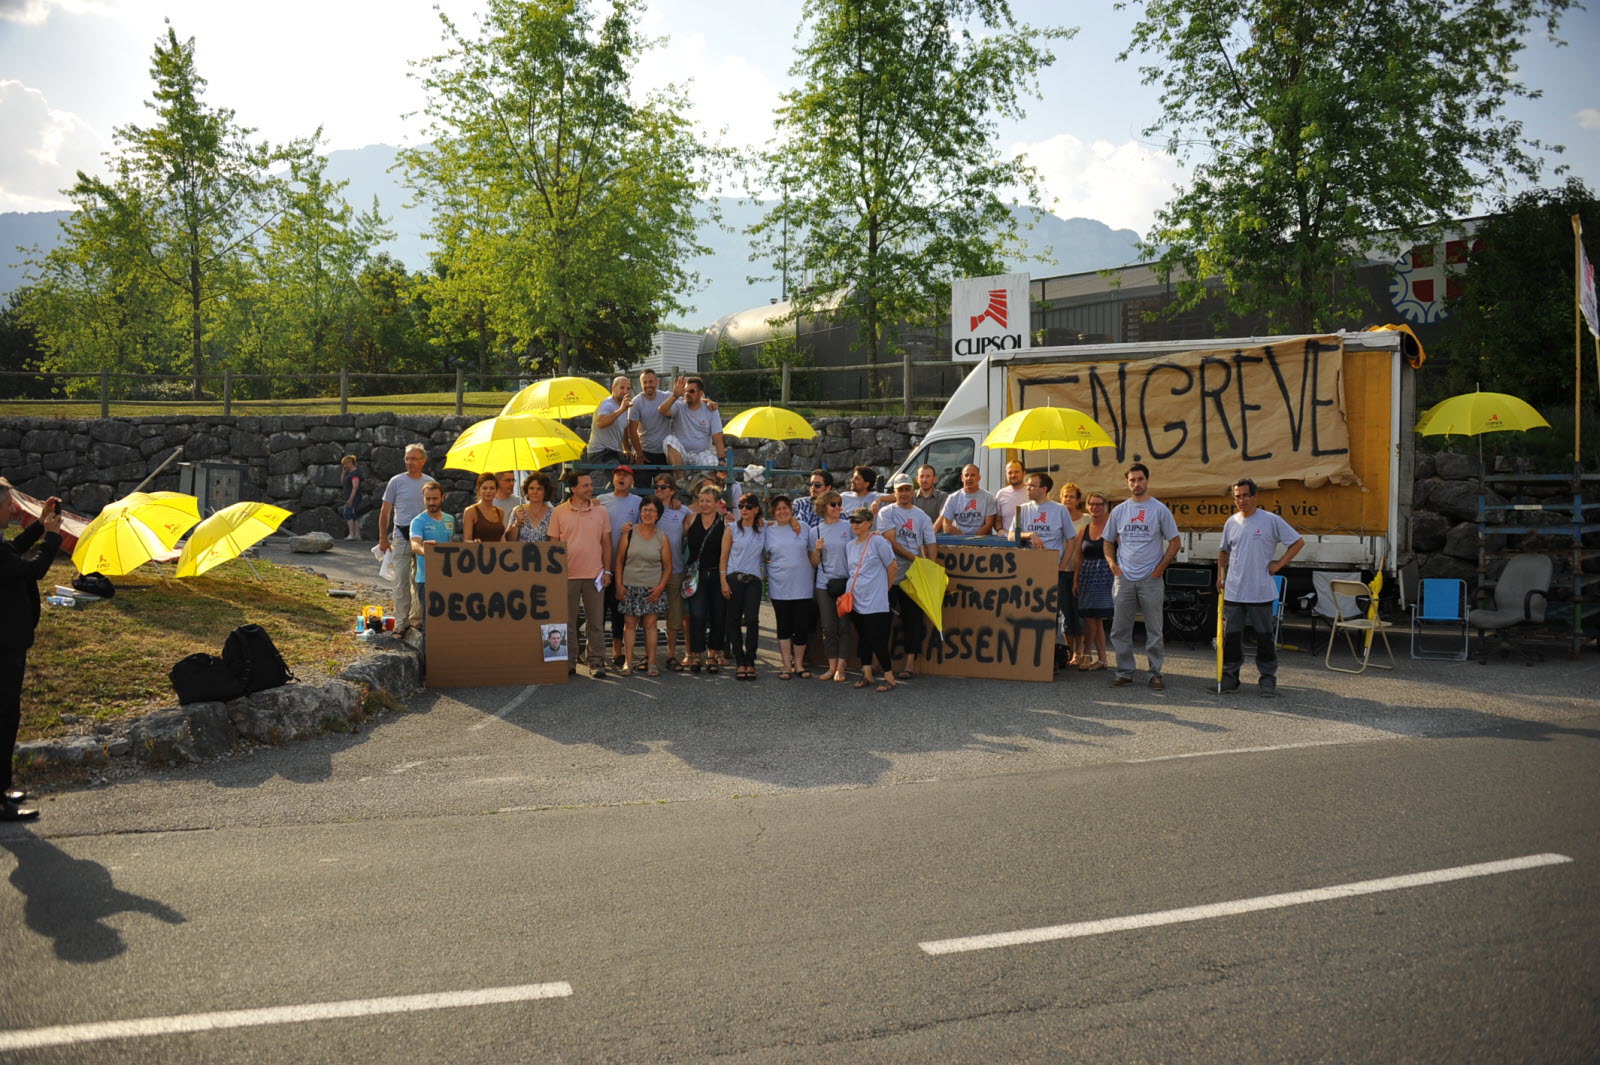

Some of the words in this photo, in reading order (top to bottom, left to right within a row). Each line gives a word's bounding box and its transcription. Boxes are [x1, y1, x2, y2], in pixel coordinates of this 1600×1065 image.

[1291, 501, 1319, 517] vie
[1124, 524, 1149, 532] CLIPSOL
[434, 543, 567, 578] TOUCAS
[427, 584, 551, 622] DEGAGE
[944, 577, 1058, 618] NTREPRiSE
